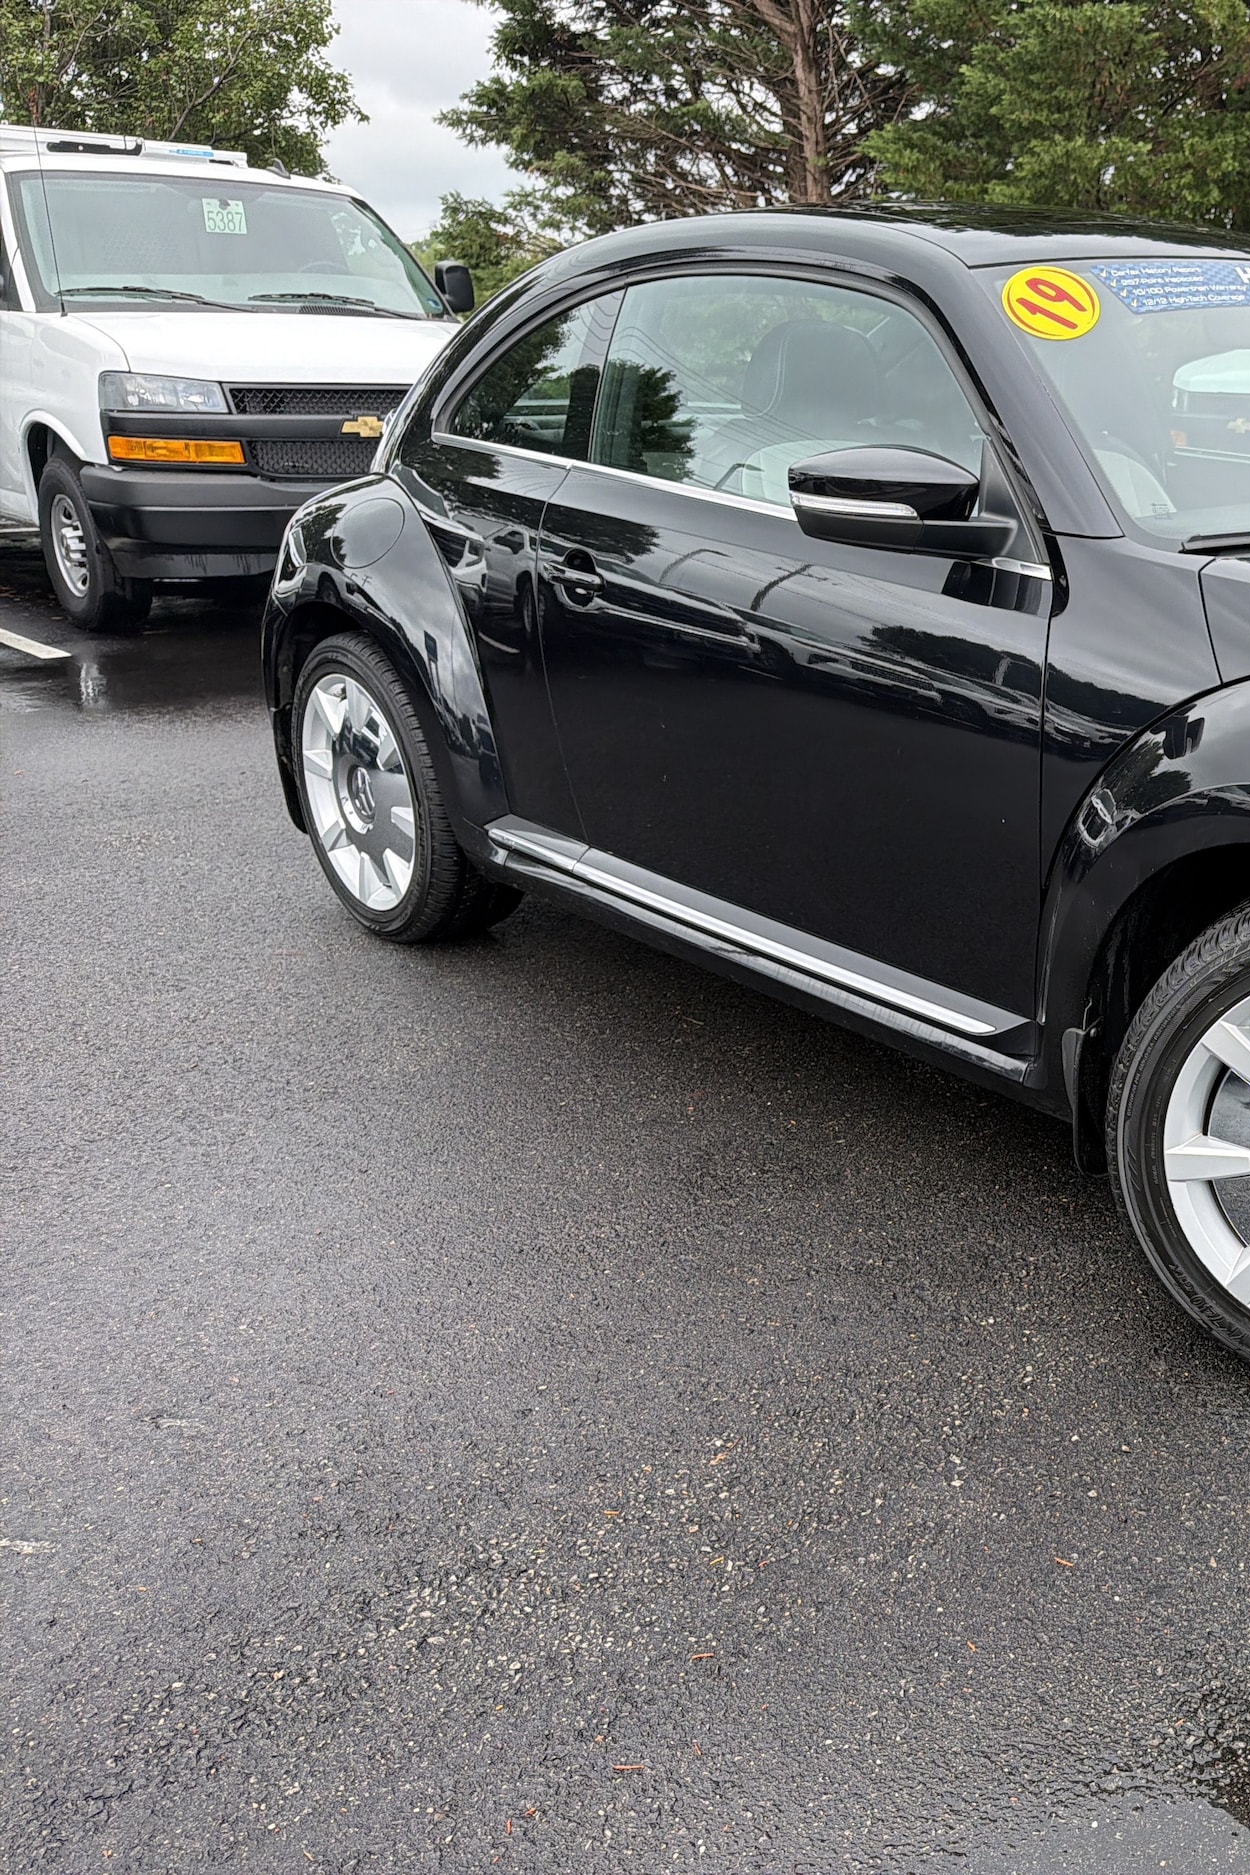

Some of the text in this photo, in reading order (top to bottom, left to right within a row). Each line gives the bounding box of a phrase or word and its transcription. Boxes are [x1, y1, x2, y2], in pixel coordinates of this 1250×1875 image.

[207, 210, 243, 232] 5387
[1132, 287, 1164, 296] 10/100
[1016, 278, 1087, 330] 19
[1142, 297, 1168, 306] 12/12
